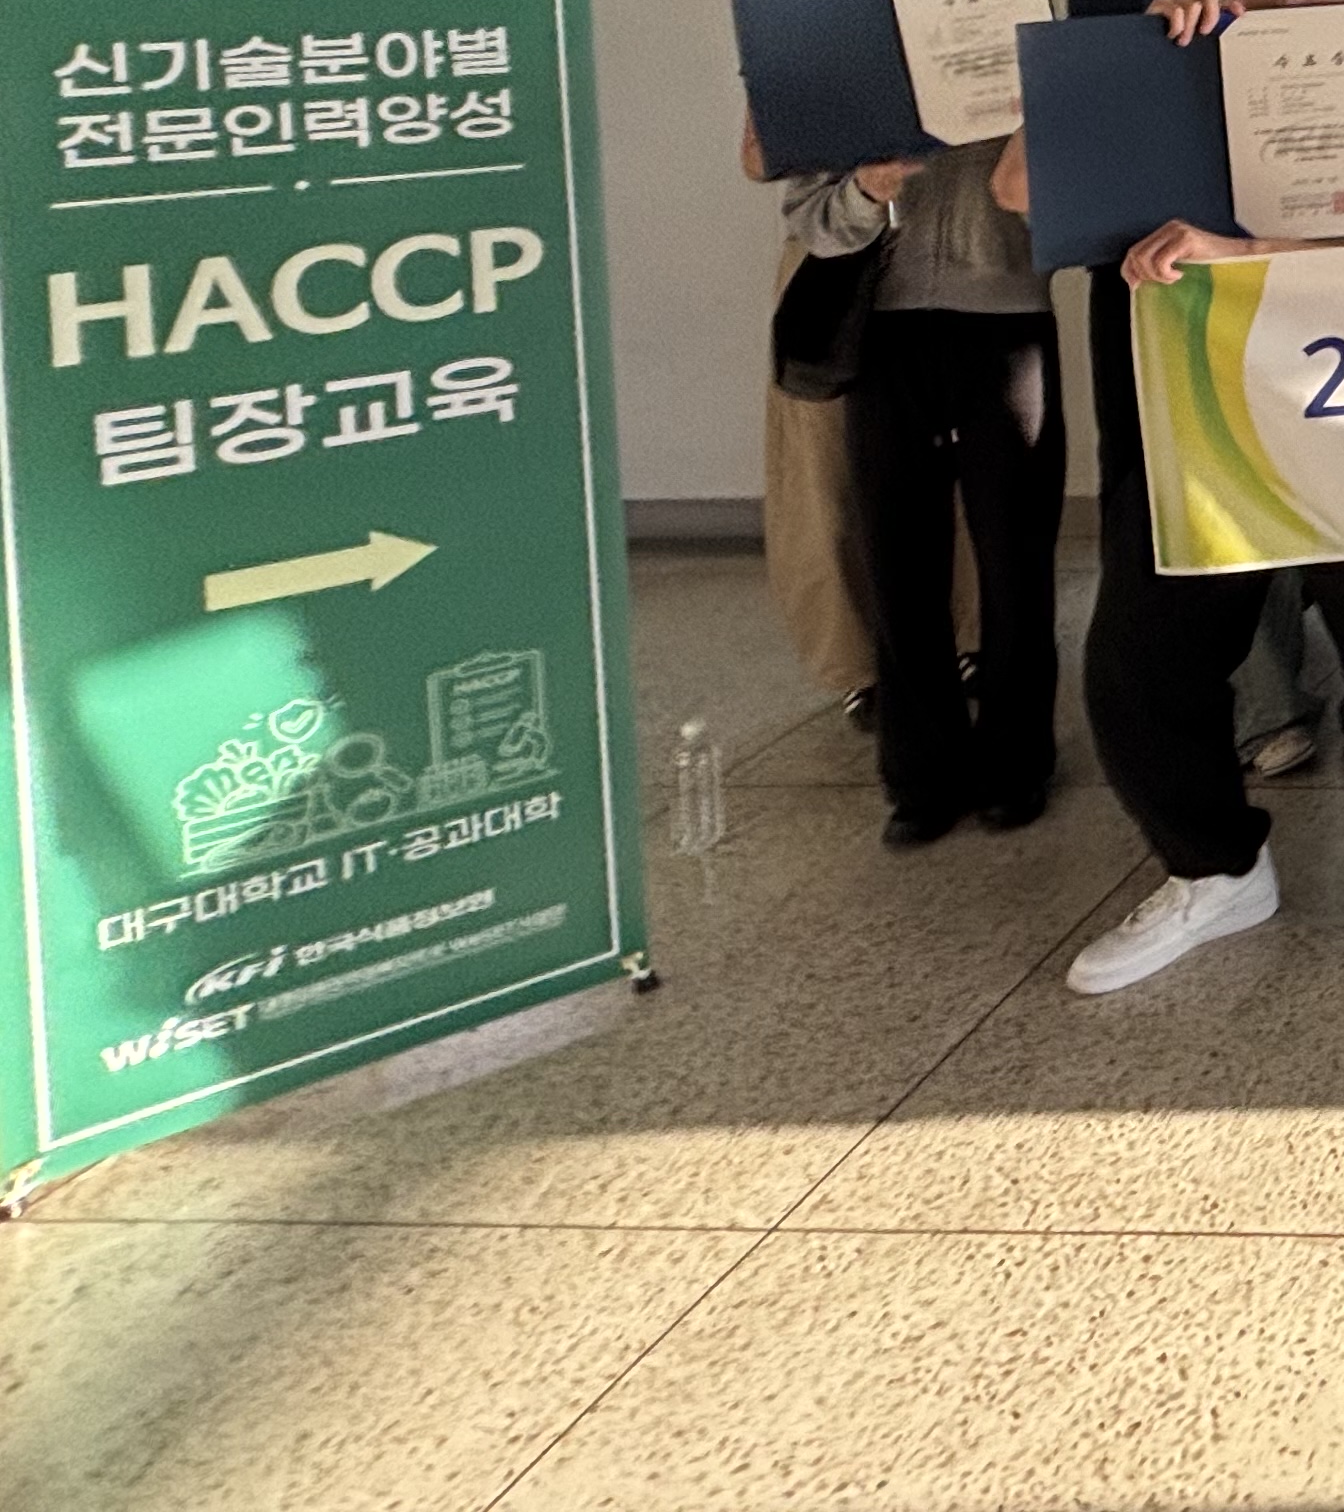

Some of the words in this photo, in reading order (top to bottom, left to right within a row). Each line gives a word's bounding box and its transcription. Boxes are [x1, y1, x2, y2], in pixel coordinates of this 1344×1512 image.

[54, 25, 512, 98] 신기술분야별
[55, 88, 514, 170] 전문인력양성
[47, 226, 545, 368] HACCP
[93, 355, 520, 487] 팀장교육
[98, 856, 329, 952] 대구대학교
